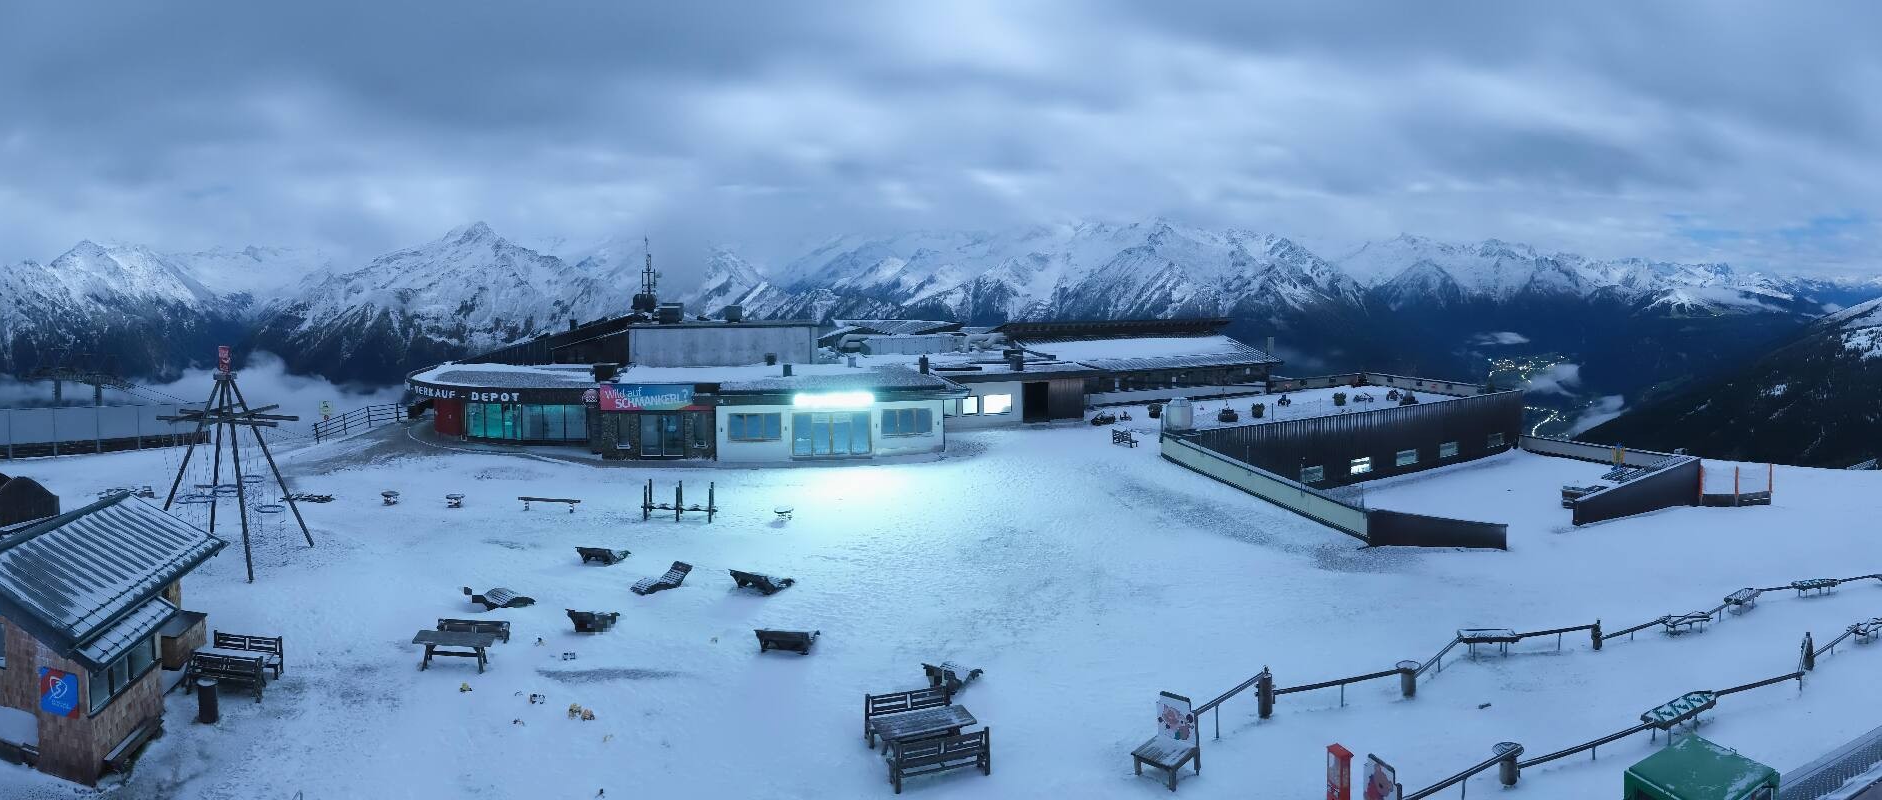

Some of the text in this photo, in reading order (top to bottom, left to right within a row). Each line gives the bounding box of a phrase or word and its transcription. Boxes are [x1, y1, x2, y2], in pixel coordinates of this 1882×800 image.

[415, 386, 456, 398] VERKAUF
[471, 392, 520, 402] DEPOT
[604, 387, 642, 399] Wild auf
[615, 389, 689, 409] SCHMANKERL?
